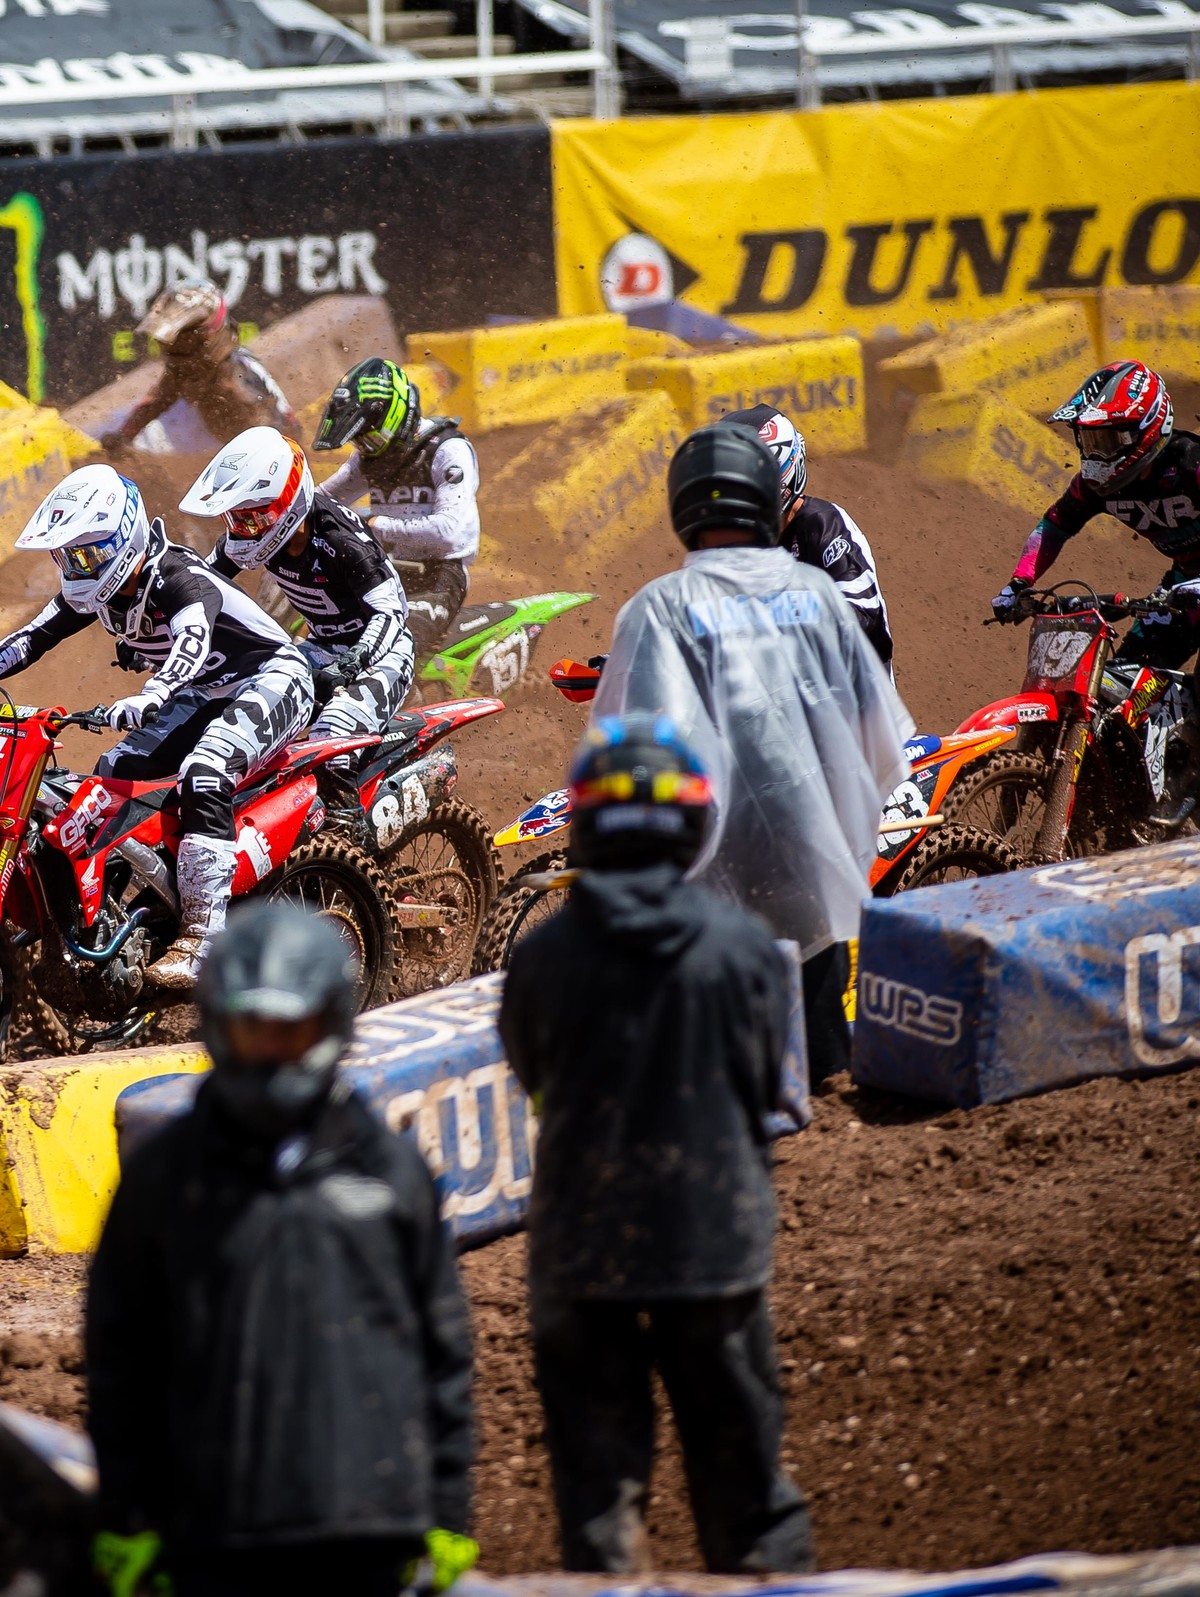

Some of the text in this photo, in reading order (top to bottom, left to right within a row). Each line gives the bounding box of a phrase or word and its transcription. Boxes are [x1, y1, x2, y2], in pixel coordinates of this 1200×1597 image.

[57, 229, 391, 318] MONSTER
[617, 263, 661, 296] D
[507, 352, 623, 383] DUNLOP
[1130, 370, 1144, 391] PURE
[706, 376, 857, 414] SUZUKI
[1105, 494, 1200, 531] FXR
[255, 511, 298, 563] GEICO
[312, 536, 336, 558] GEICO
[97, 548, 137, 603] GEICO
[278, 566, 301, 580] SHIFT
[156, 625, 206, 686] GEICO
[380, 731, 407, 744] NDA
[974, 736, 1002, 752] DUNLOP
[59, 784, 113, 848] GEICO
[81, 877, 101, 891] HONDA
[860, 971, 963, 1047] WPS
